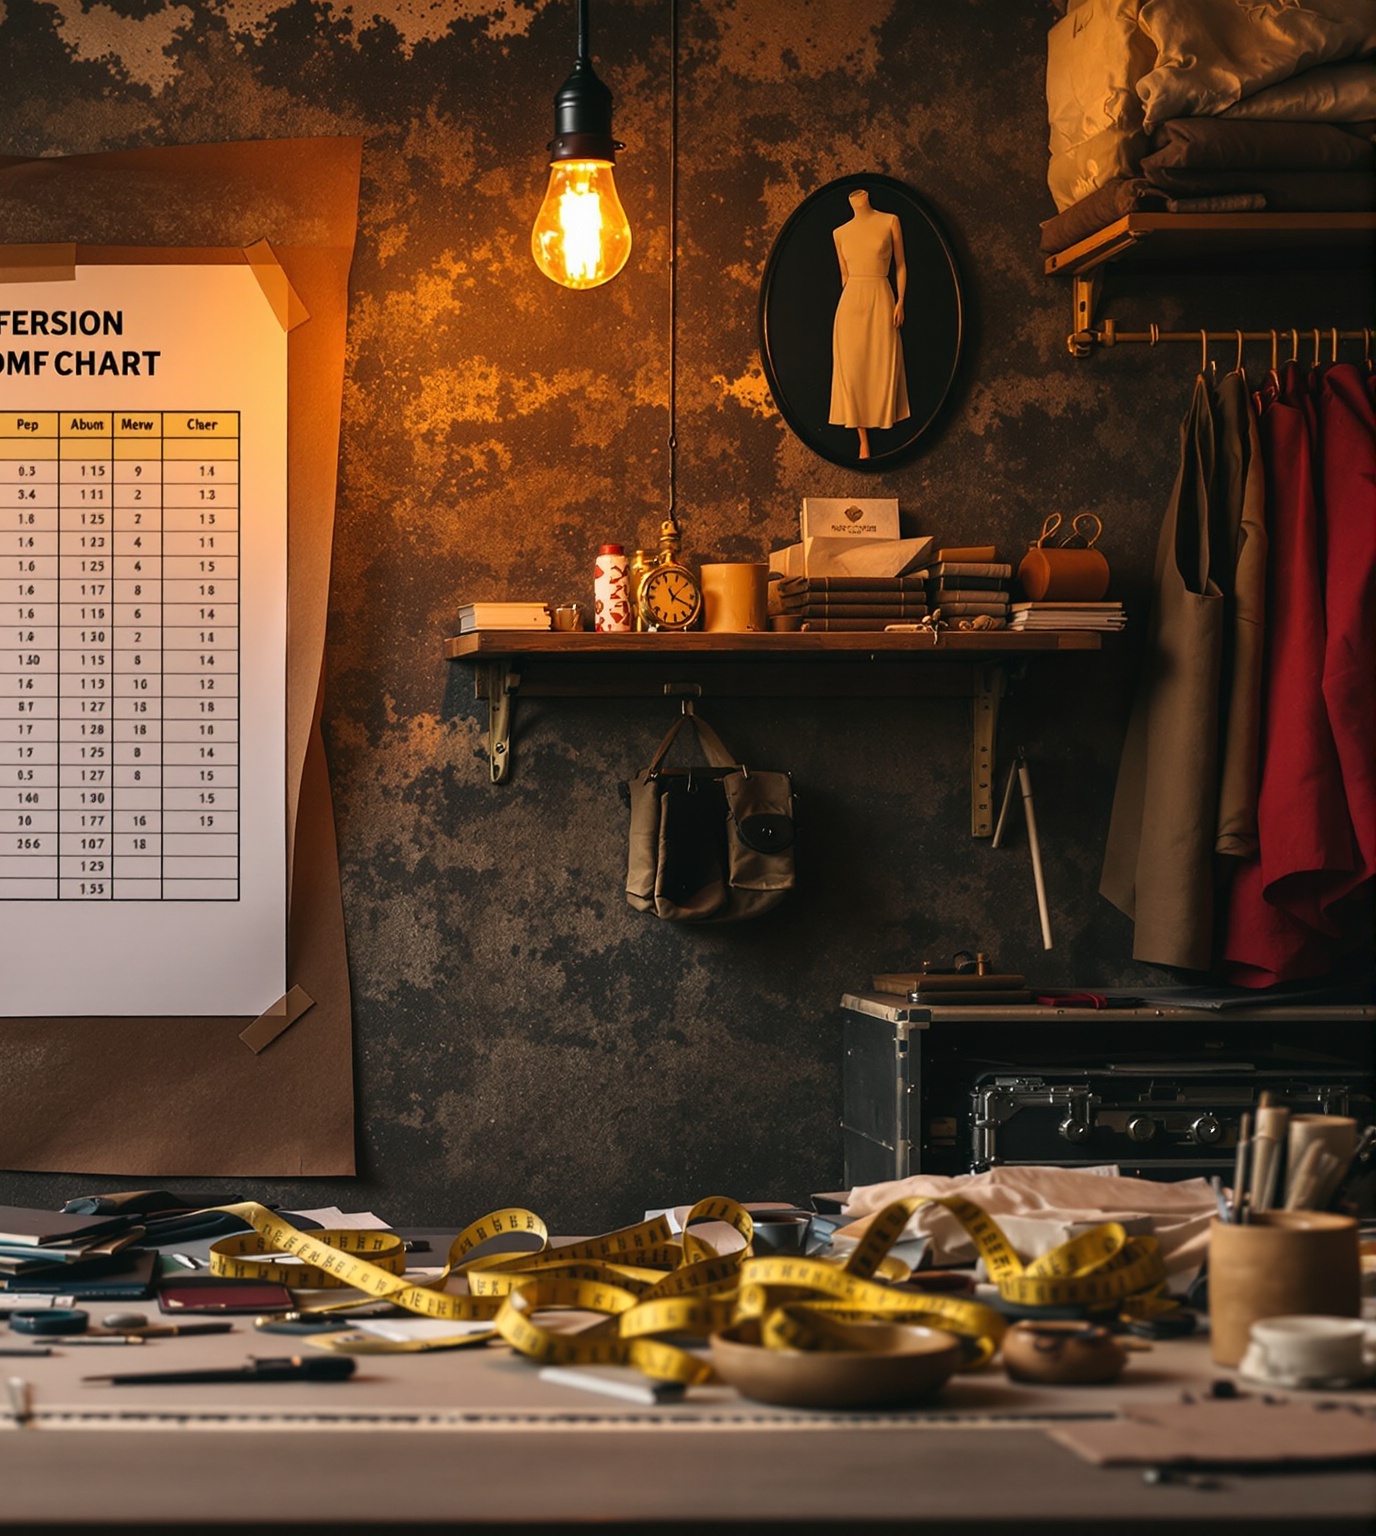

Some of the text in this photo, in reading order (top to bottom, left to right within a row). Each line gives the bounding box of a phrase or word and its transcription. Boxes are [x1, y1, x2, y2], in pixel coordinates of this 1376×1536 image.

[54, 350, 161, 376] CHART
[16, 418, 39, 433] Pep
[134, 465, 143, 477] 9
[134, 489, 142, 501] 2
[133, 536, 142, 548] 4
[134, 584, 142, 596] 8
[133, 608, 142, 620] 6
[134, 631, 142, 643] 2
[133, 769, 141, 781] 8
